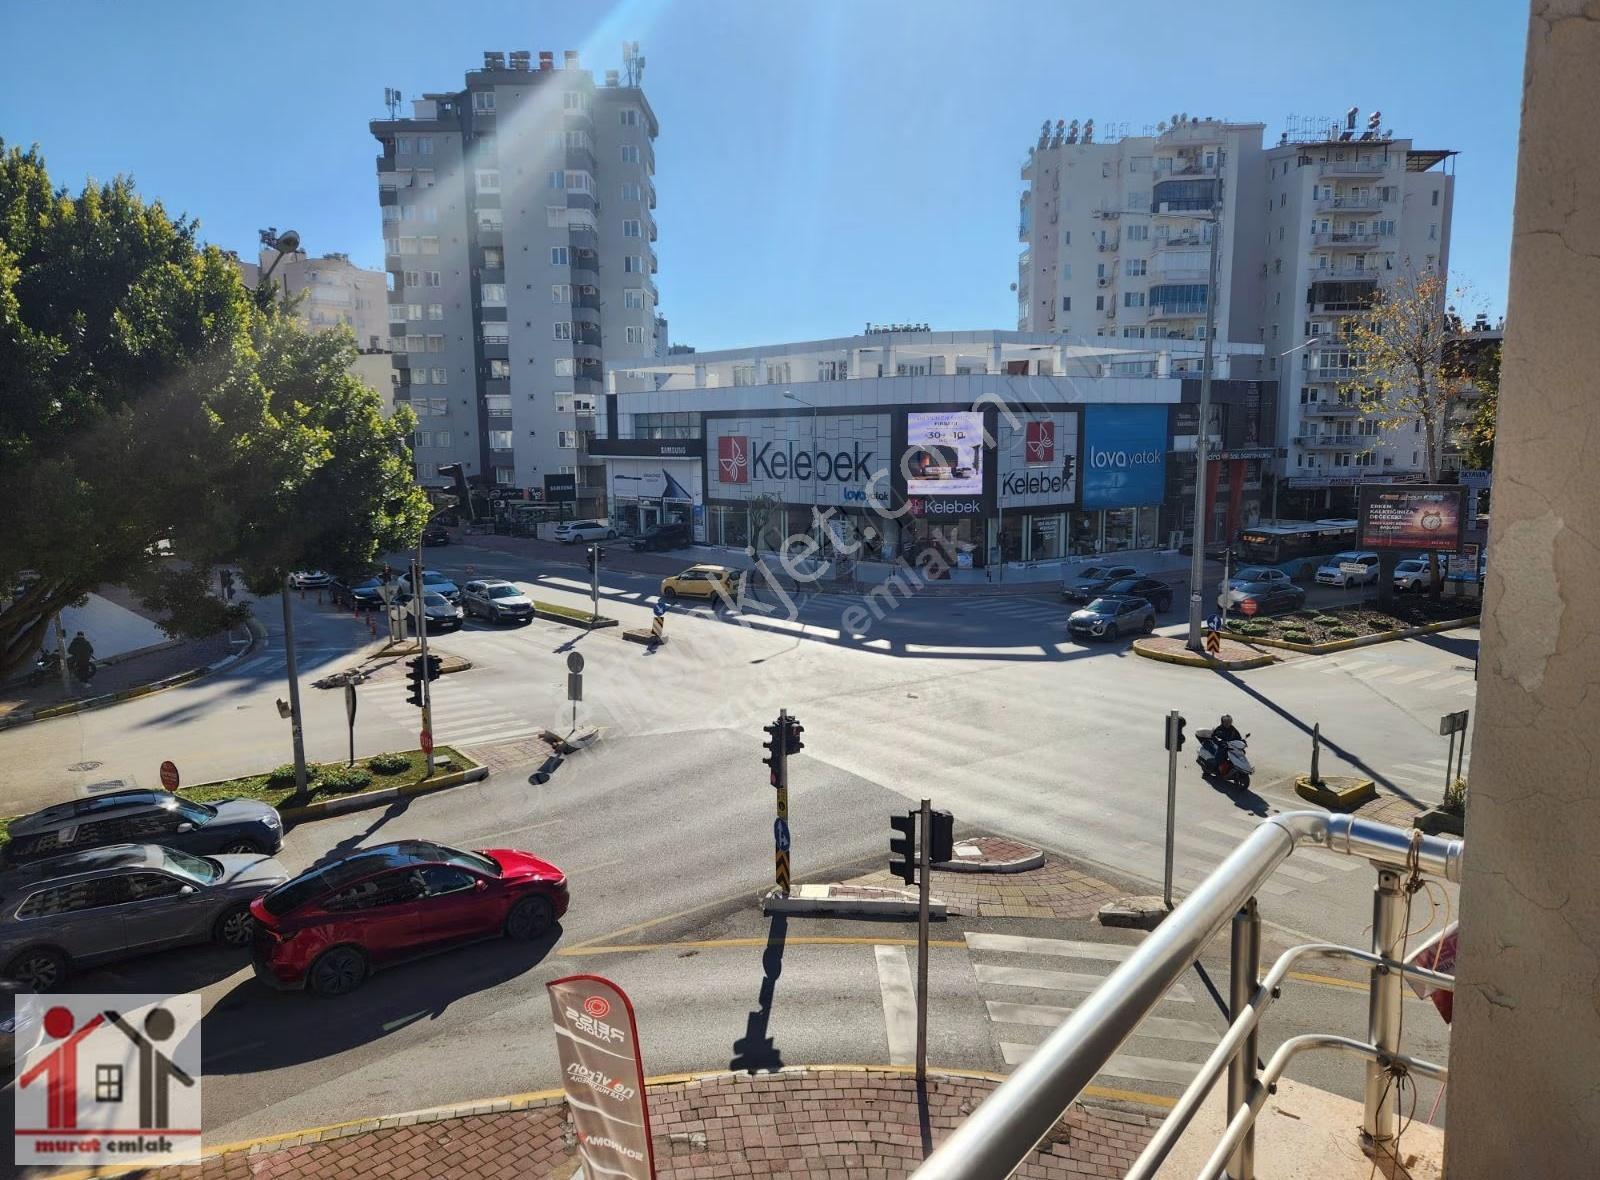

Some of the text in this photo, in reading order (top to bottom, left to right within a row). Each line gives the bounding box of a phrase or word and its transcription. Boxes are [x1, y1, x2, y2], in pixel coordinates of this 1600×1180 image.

[752, 441, 873, 482] Kelebek
[1090, 446, 1161, 469] lova yatak
[1001, 472, 1073, 496] Kelebek
[925, 500, 981, 513] Kelebek
